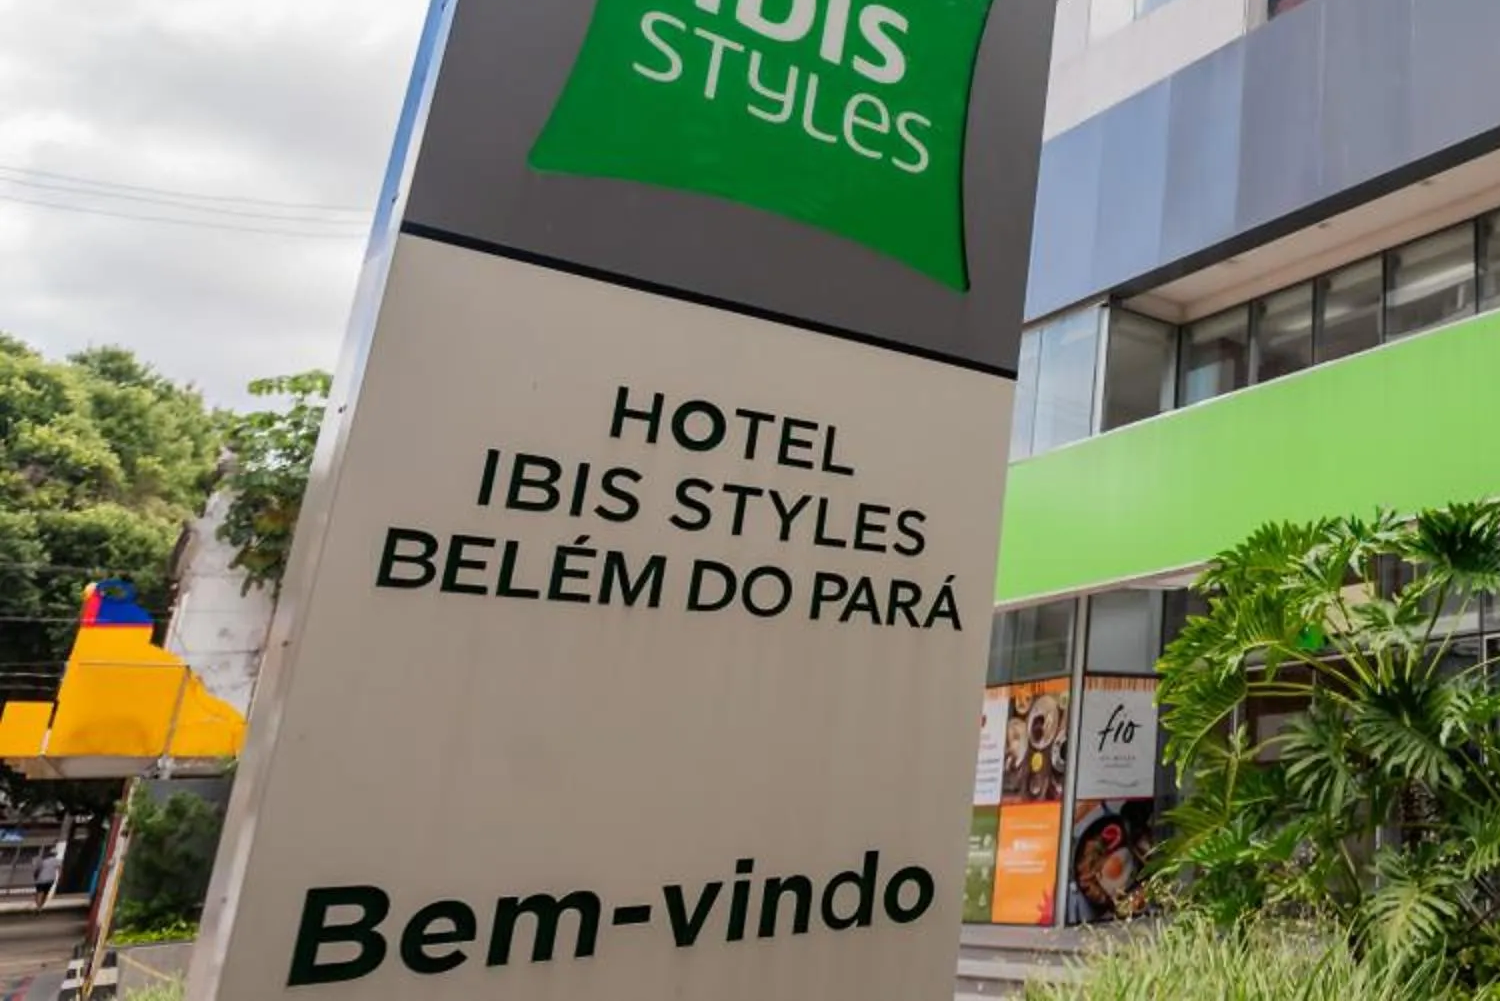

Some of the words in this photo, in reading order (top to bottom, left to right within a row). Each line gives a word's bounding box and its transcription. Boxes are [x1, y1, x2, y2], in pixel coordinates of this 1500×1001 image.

[608, 385, 855, 476] HOTEL
[476, 448, 643, 523] IBIS
[668, 476, 927, 556] STYLES
[375, 526, 667, 609] BELÉM
[685, 558, 793, 618] DO
[808, 573, 963, 631] PARÁ
[286, 850, 935, 987] Bem-vindo
